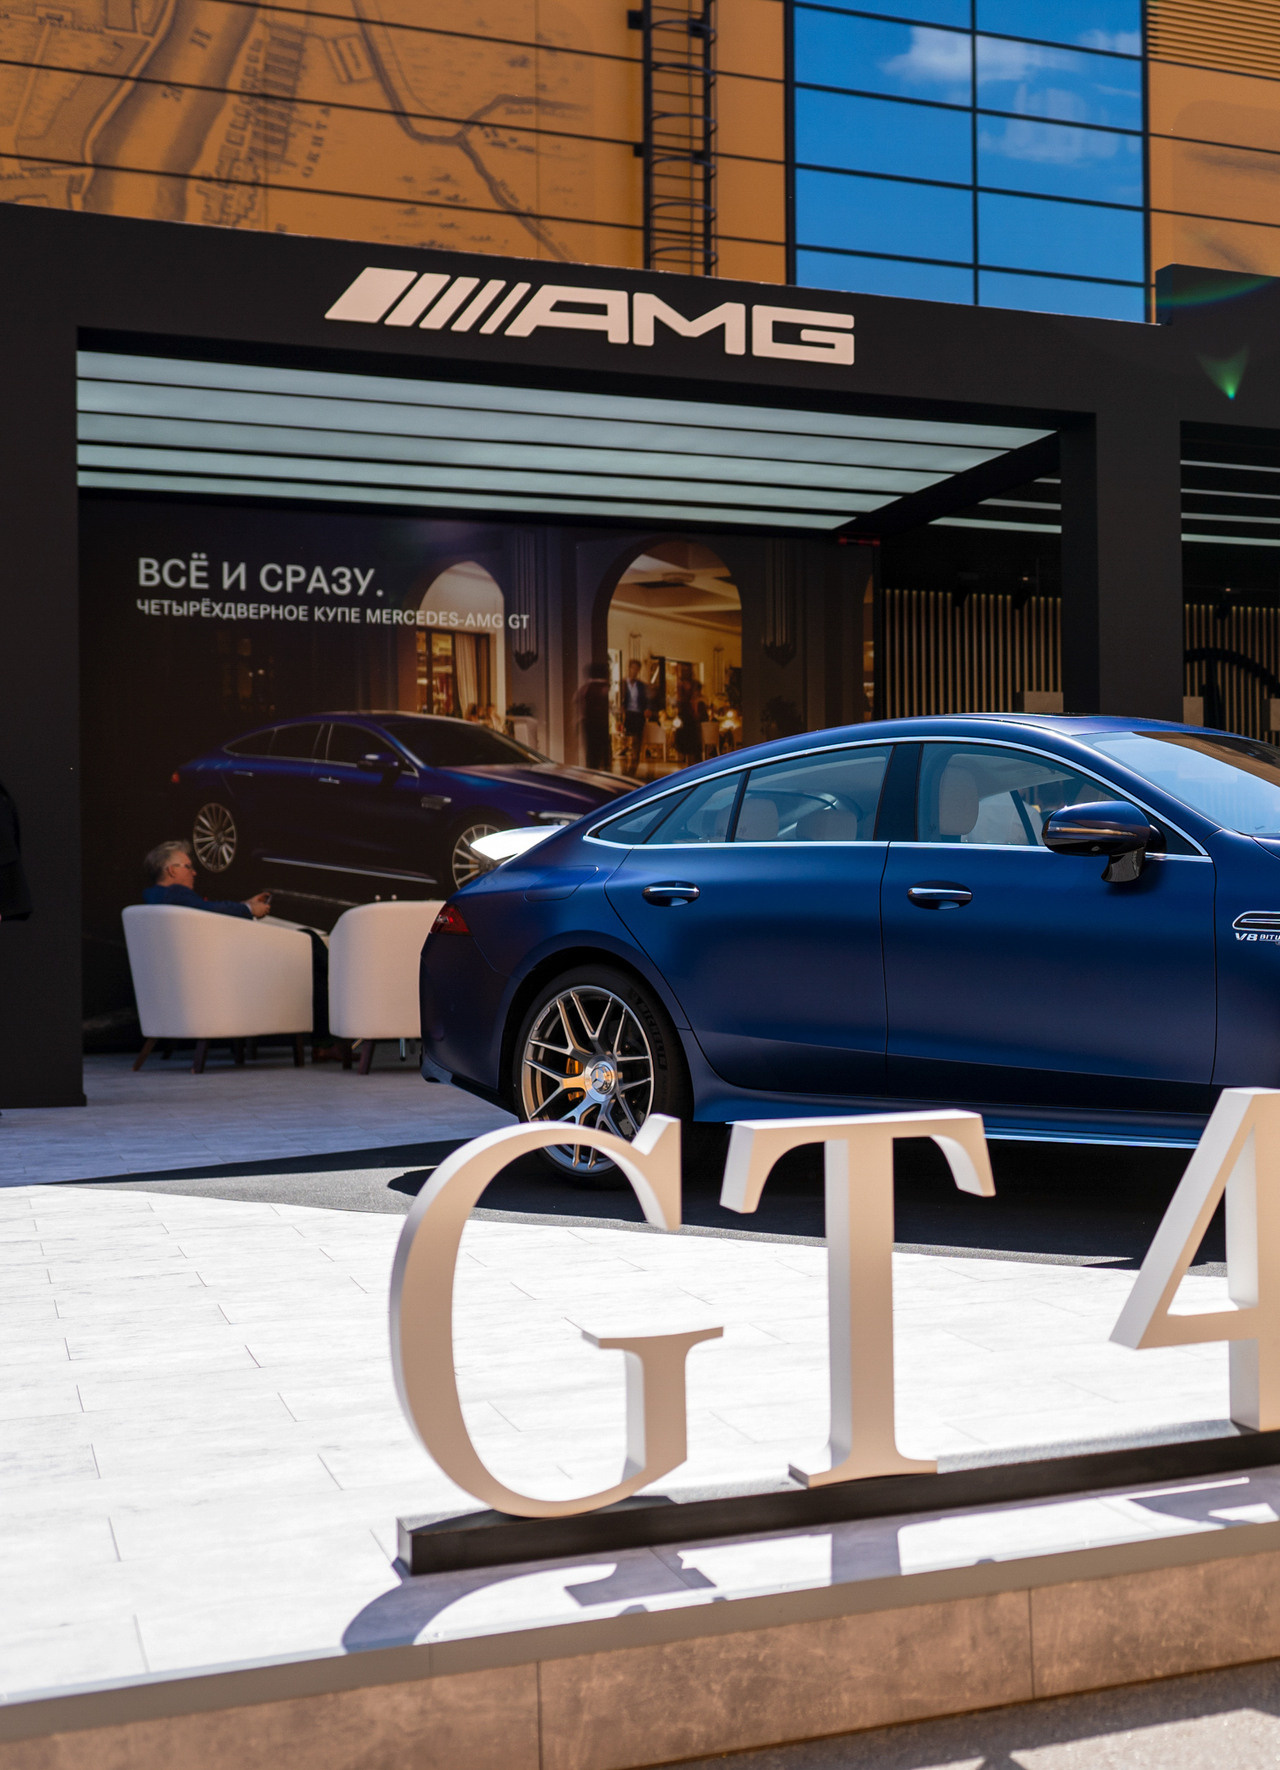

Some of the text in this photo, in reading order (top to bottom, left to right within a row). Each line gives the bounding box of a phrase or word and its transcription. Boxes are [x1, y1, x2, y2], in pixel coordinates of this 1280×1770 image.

[504, 284, 854, 365] AMG
[138, 552, 384, 598] ВСЁ И СРАЗУ.
[136, 598, 530, 630] ЧЕТЫРЁХДВЕРНОЕ КУПЕ MERCEDES-AMG GT
[1235, 932, 1258, 941] V8
[389, 1108, 997, 1519] GT
